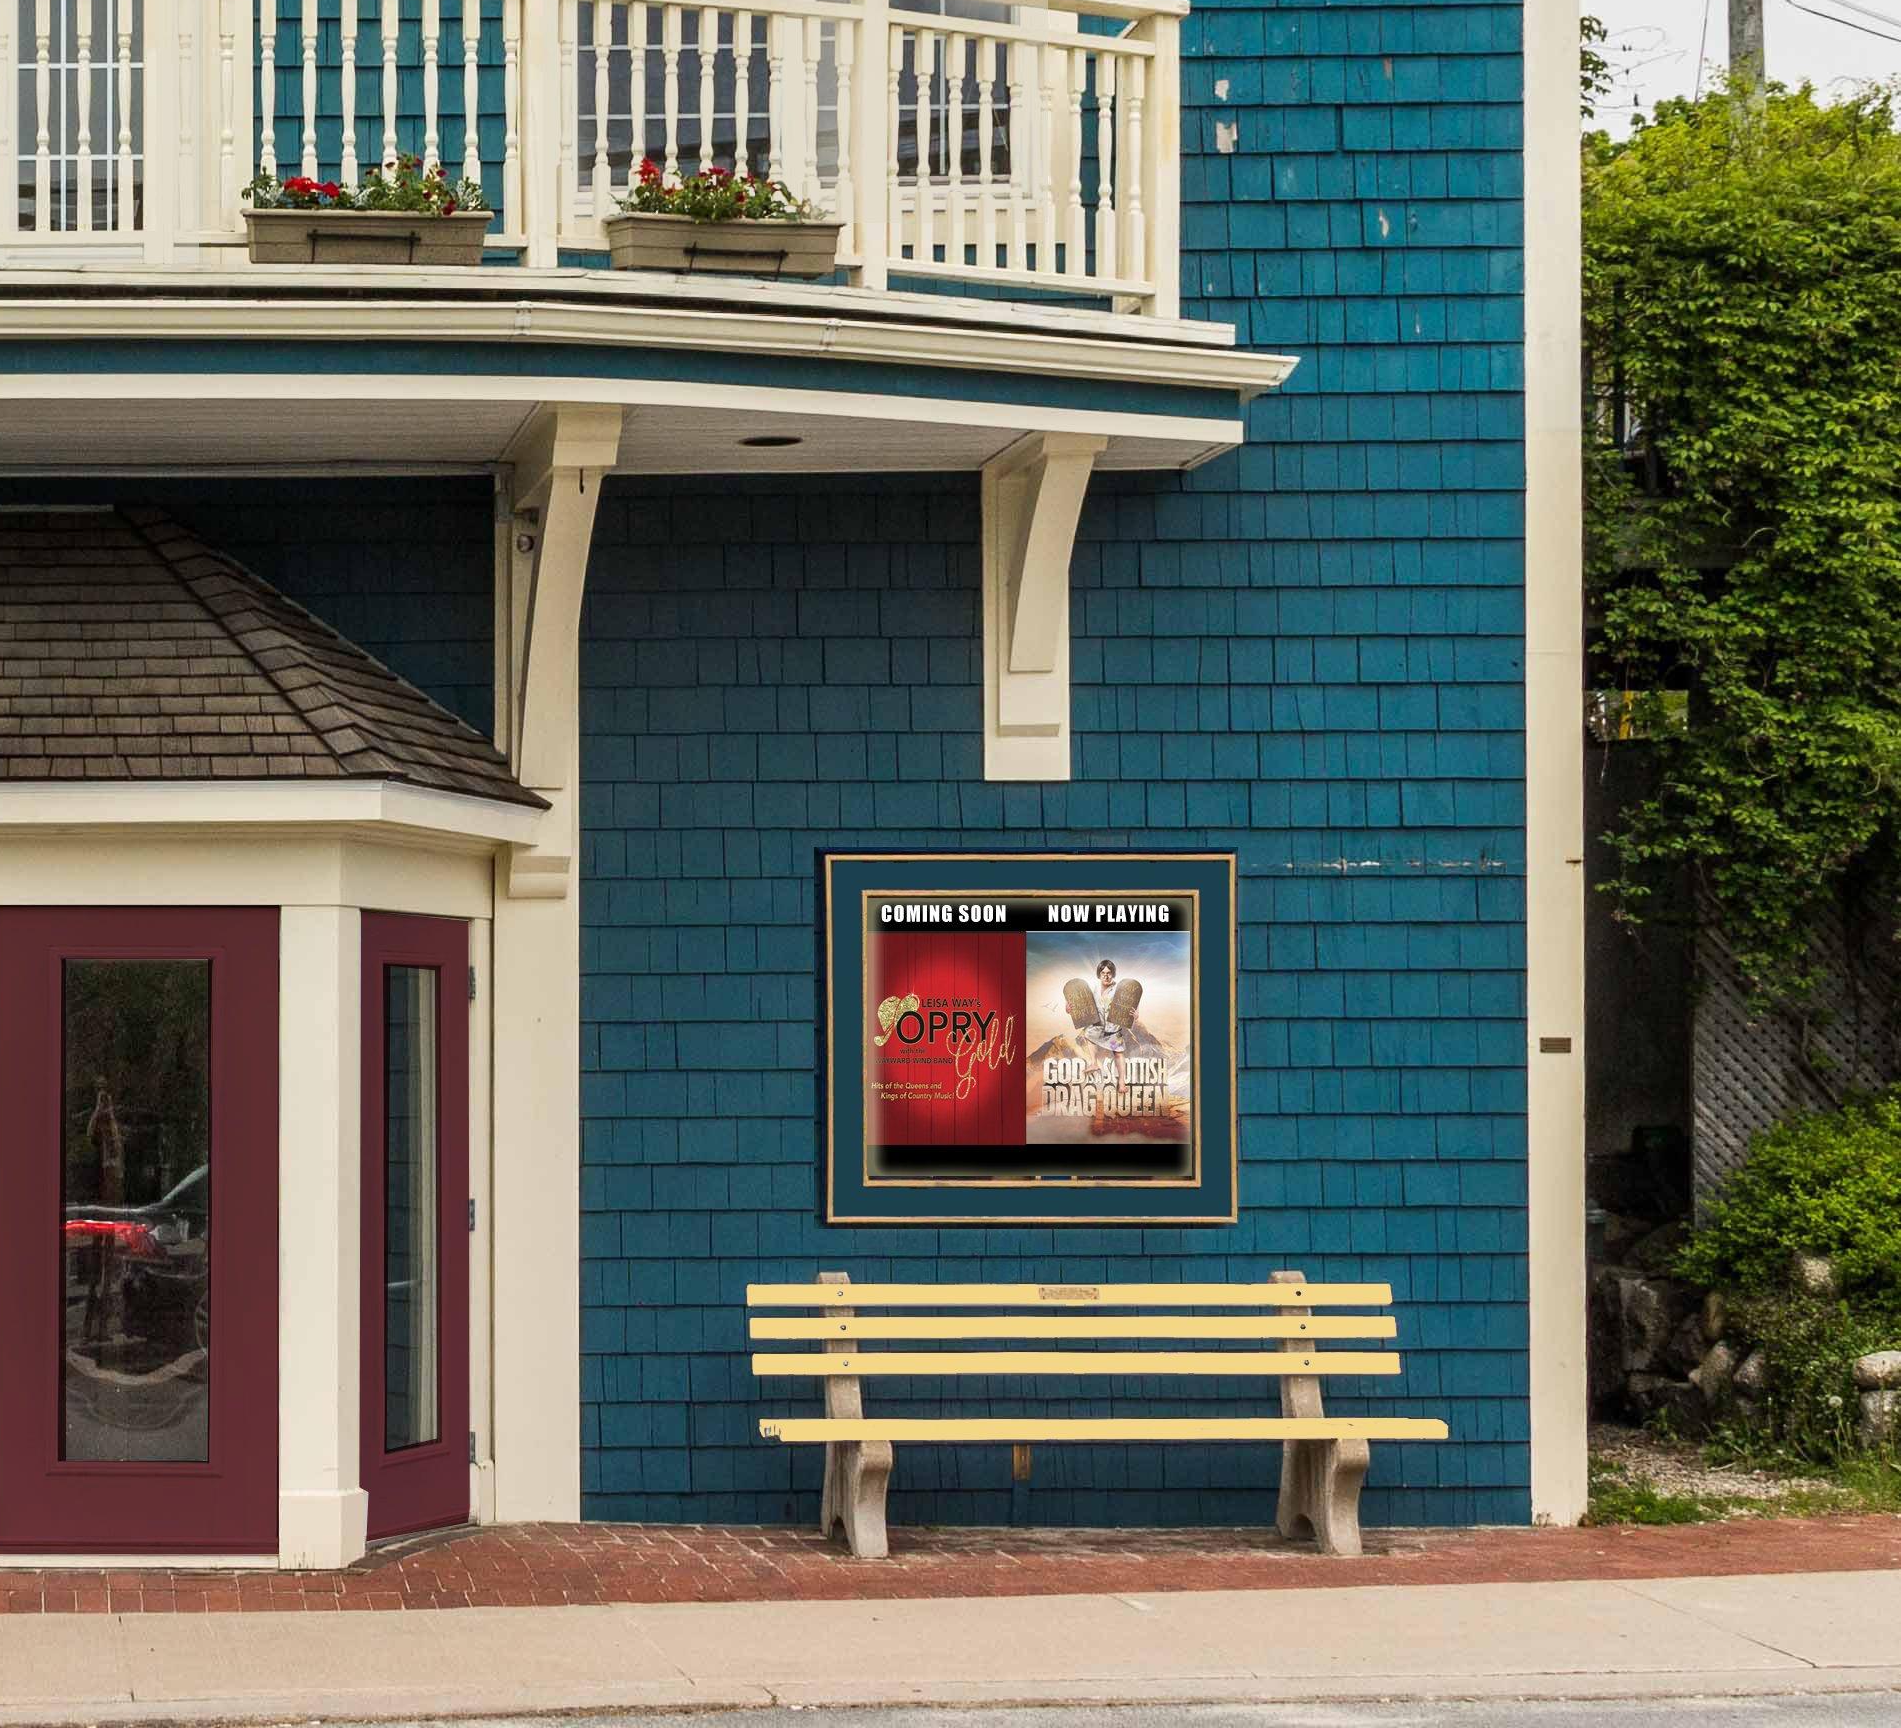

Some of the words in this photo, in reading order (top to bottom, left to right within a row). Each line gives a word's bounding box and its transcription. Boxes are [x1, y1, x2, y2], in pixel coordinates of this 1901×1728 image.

[881, 905, 953, 923] COMING
[959, 905, 1007, 923] SOON
[1048, 905, 1089, 923] NOW
[1095, 905, 1169, 923] PLAYING
[922, 999, 948, 1008] LEISA
[896, 1010, 995, 1044] OPRY
[946, 1016, 1016, 1100] Gold
[1043, 1058, 1085, 1084] GOD
[906, 1082, 928, 1090] Queens
[881, 1093, 898, 1101] Kings
[908, 1093, 932, 1101] Country
[1042, 1085, 1097, 1116] DRAG
[1103, 1085, 1168, 1119] QUEEN
